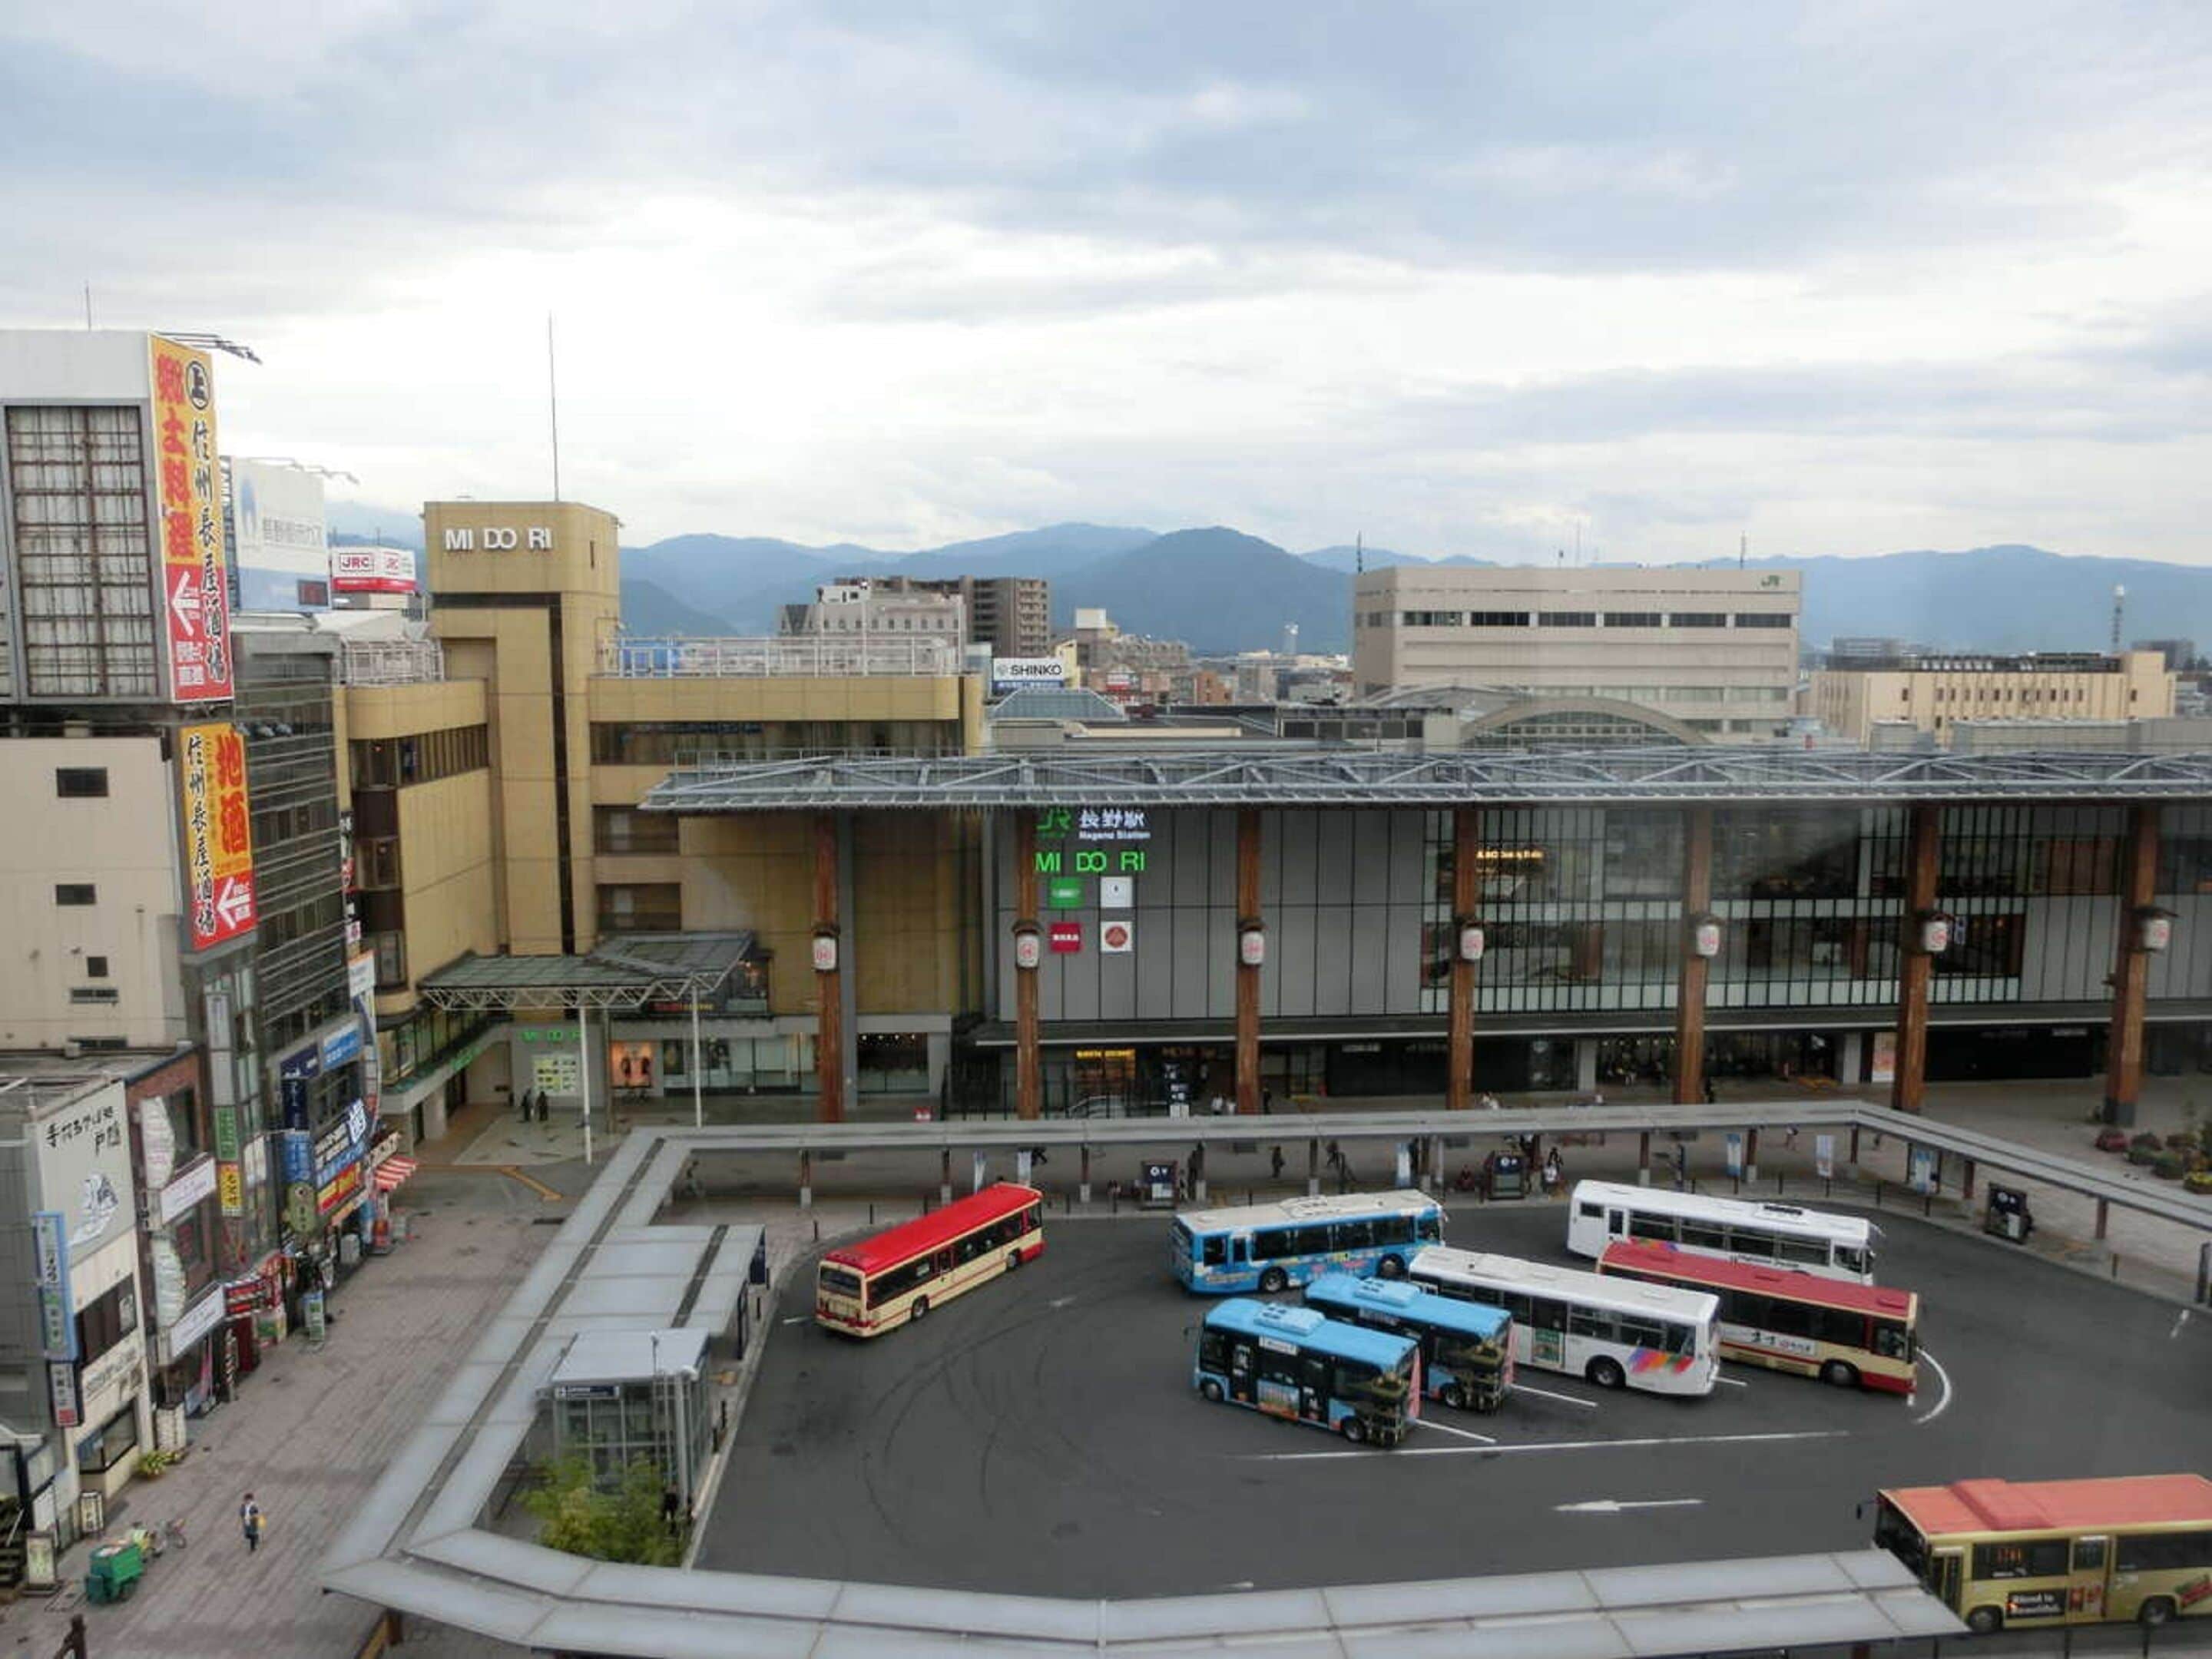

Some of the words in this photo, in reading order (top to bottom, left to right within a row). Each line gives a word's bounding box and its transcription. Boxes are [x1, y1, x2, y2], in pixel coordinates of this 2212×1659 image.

[445, 528, 473, 550] MI
[484, 528, 517, 549] DO
[528, 528, 552, 549] RI
[343, 557, 371, 568] JRC
[1010, 664, 1062, 676] SHINKO
[1037, 809, 1071, 830] JR
[1079, 809, 1145, 829] 長野駅
[1036, 853, 1061, 872] MI
[1076, 853, 1107, 871] DO
[1121, 852, 1144, 871] RI
